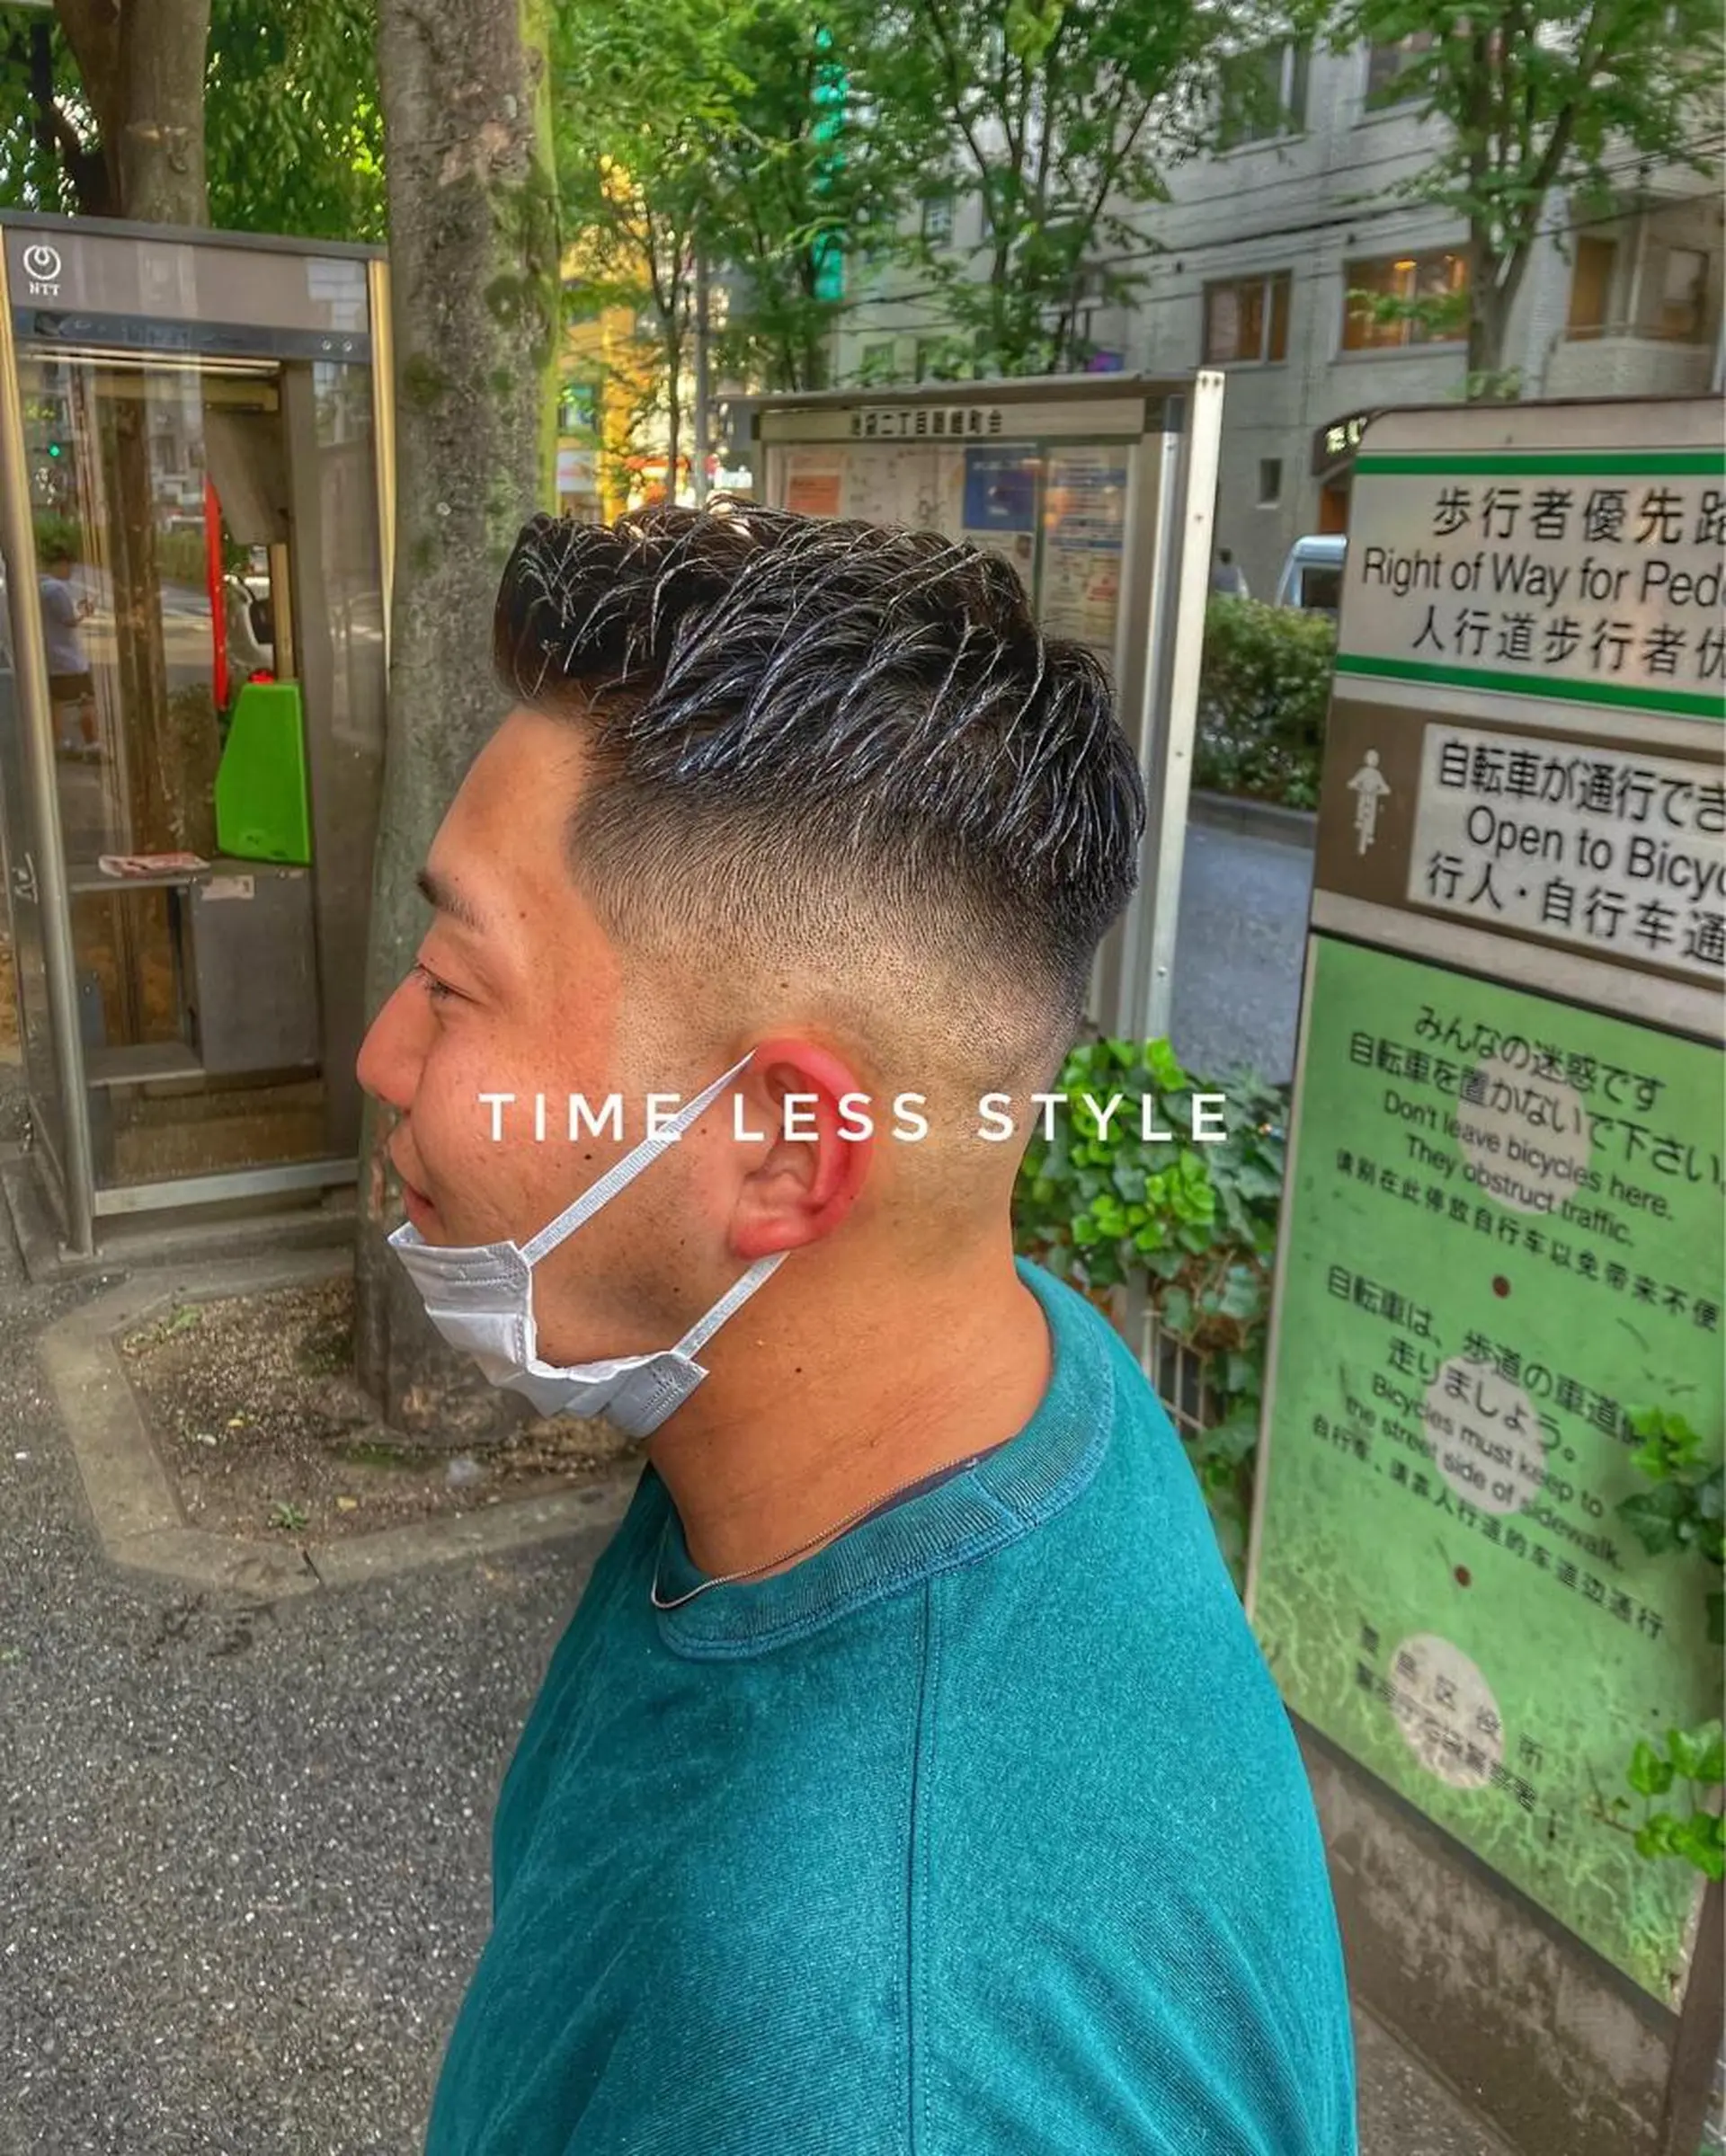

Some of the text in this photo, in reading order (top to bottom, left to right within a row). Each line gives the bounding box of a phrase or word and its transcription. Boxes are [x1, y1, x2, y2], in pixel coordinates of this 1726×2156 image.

[29, 281, 61, 297] NTT
[1363, 547, 1726, 608] Right of Way for Ped
[1466, 805, 1563, 861] Open
[1579, 829, 1614, 871] to
[1415, 1006, 1667, 1112] みんなの迷惑です
[1383, 1090, 1676, 1221] Don't leave bicycles here.
[1405, 1133, 1635, 1247] They obstruct traffic.
[1371, 1372, 1455, 1437] Bicycles
[1460, 1424, 1515, 1468] must
[1580, 1487, 1604, 1520] to
[1491, 1477, 1516, 1509] of
